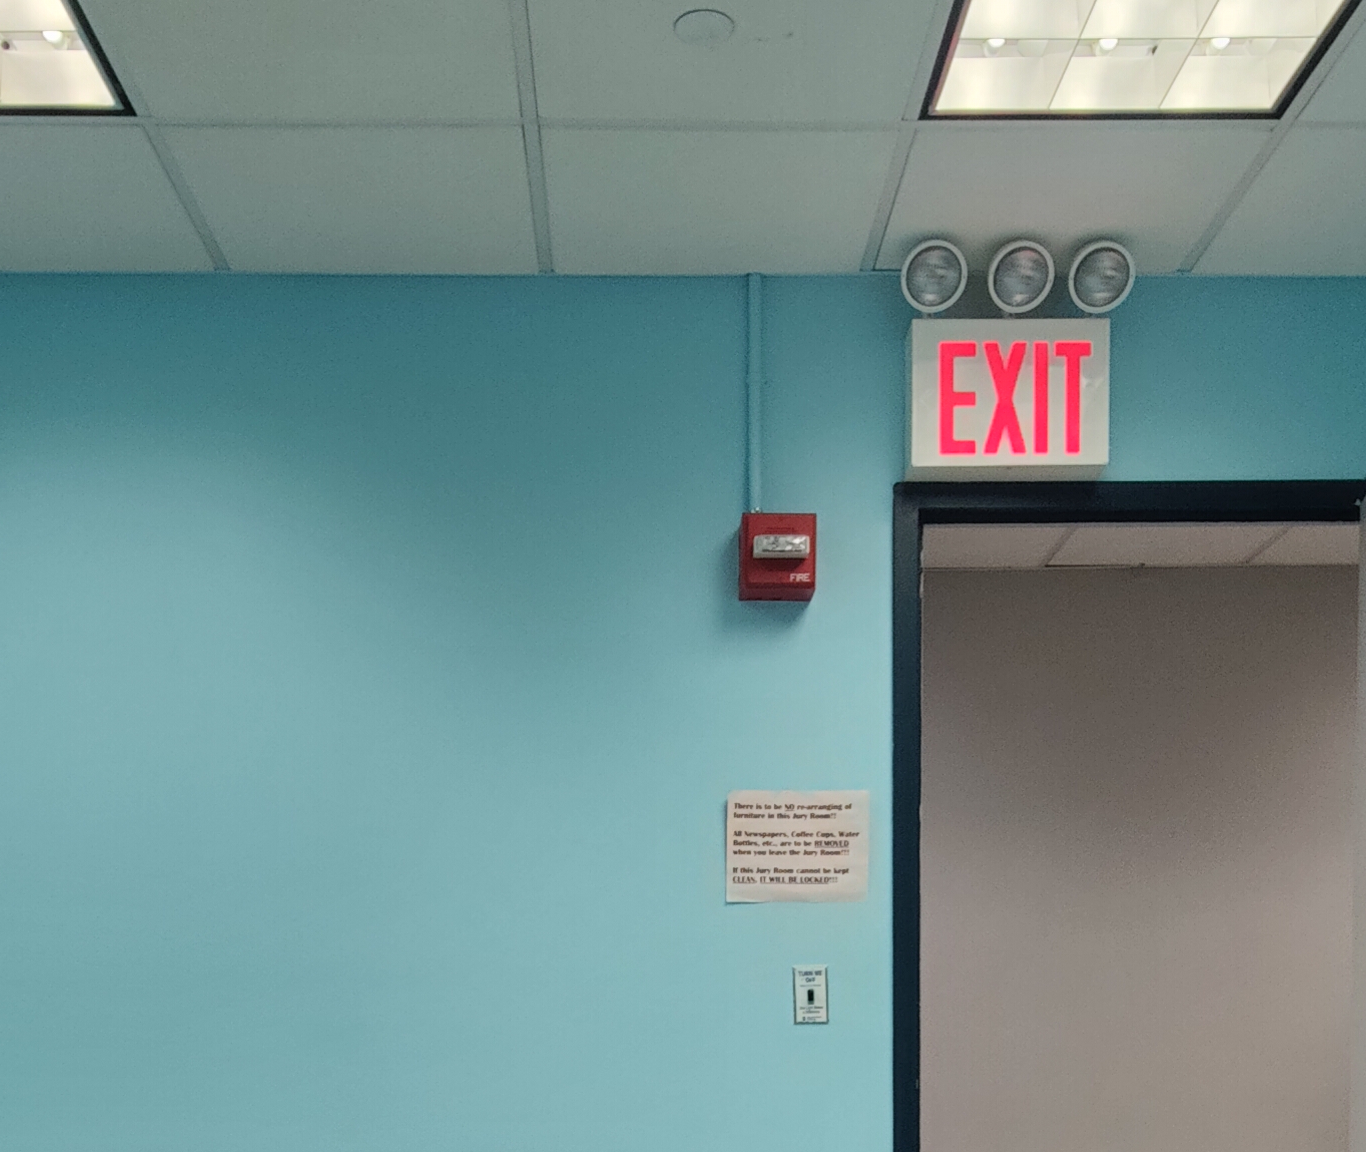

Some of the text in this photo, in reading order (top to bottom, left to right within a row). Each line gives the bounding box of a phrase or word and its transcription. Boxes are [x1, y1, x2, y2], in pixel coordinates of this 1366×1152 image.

[938, 341, 1092, 456] EXIT
[789, 573, 811, 582] FIRE
[793, 813, 807, 821] Jury
[814, 840, 849, 848] REMOVED
[760, 876, 766, 884] IT
[769, 876, 785, 884] WILL
[788, 876, 797, 884] BE
